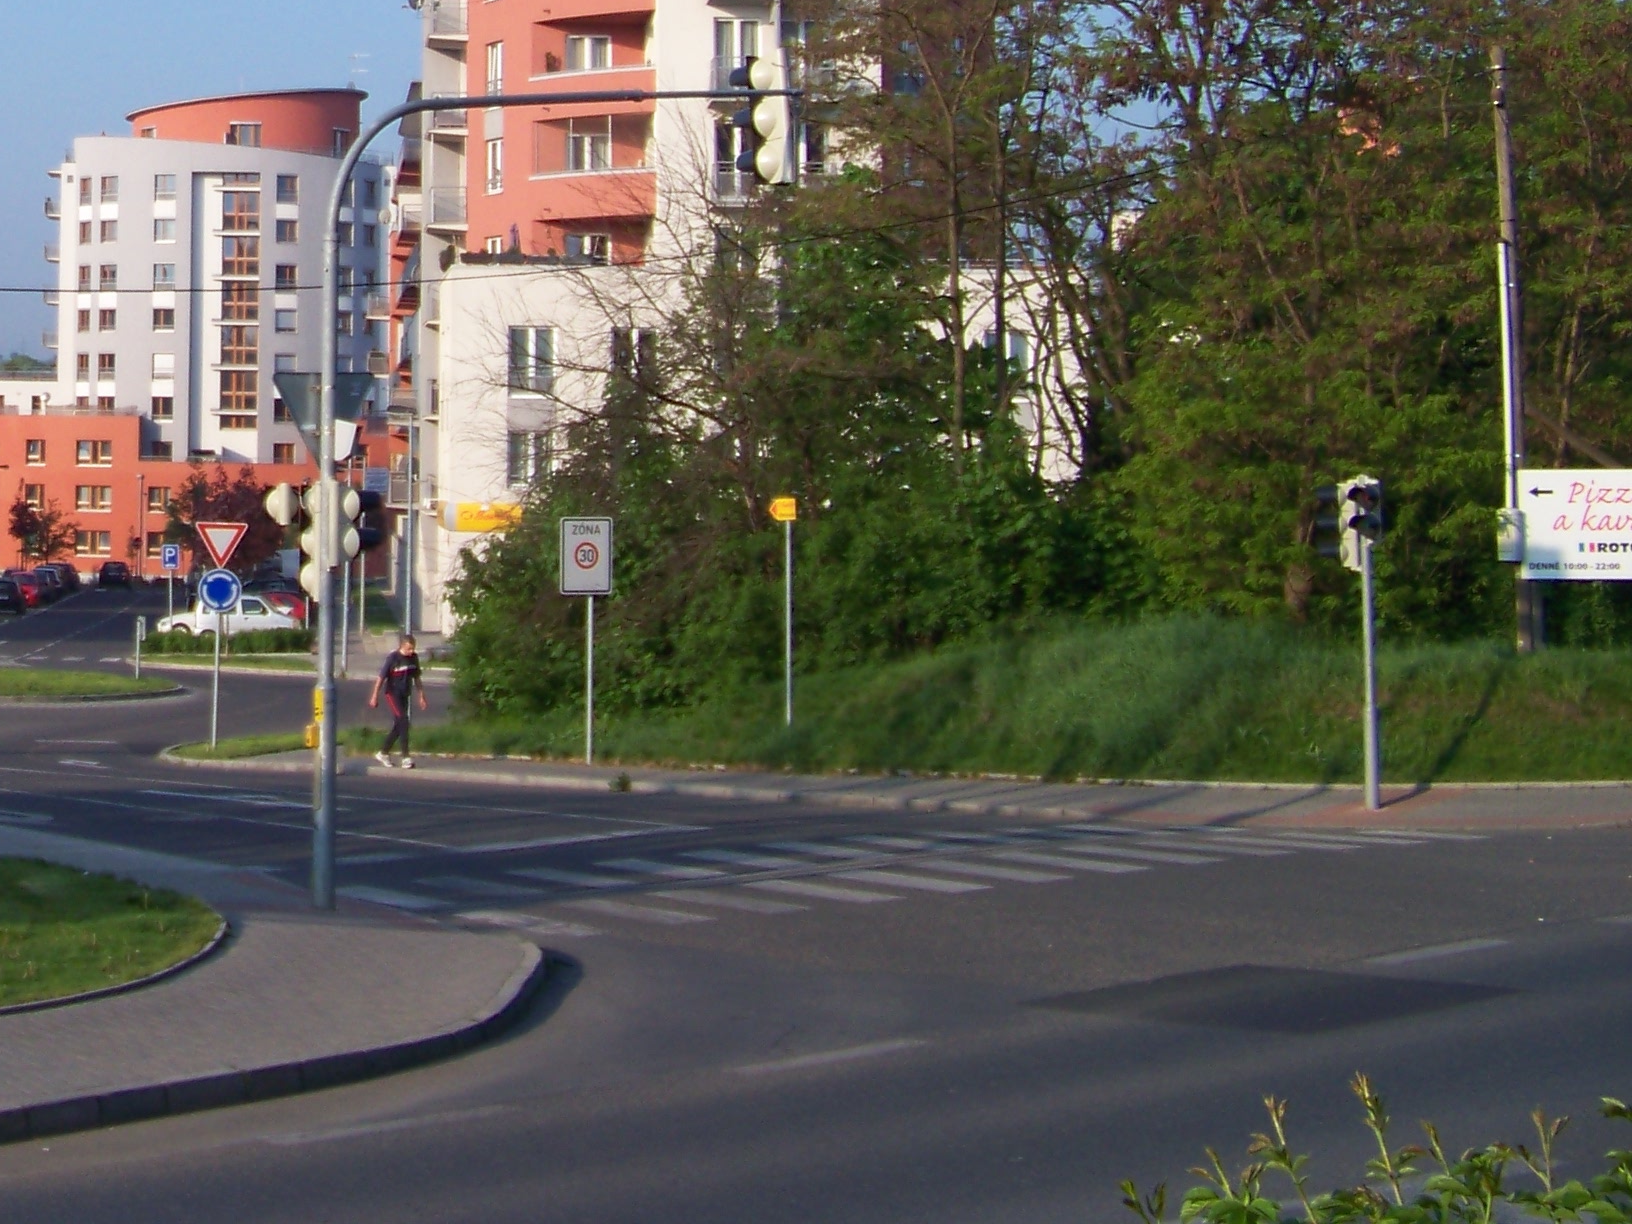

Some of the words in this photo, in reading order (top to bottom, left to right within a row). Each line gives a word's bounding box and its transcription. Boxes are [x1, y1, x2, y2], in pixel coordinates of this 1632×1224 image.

[1553, 514, 1573, 531] a
[1581, 505, 1632, 531] kav
[572, 522, 601, 535] ZÓNA
[1597, 542, 1632, 553] ROT
[165, 547, 176, 562] P
[579, 549, 594, 563] 30
[1564, 562, 1588, 571] 10:00
[1595, 562, 1621, 571] 22:00
